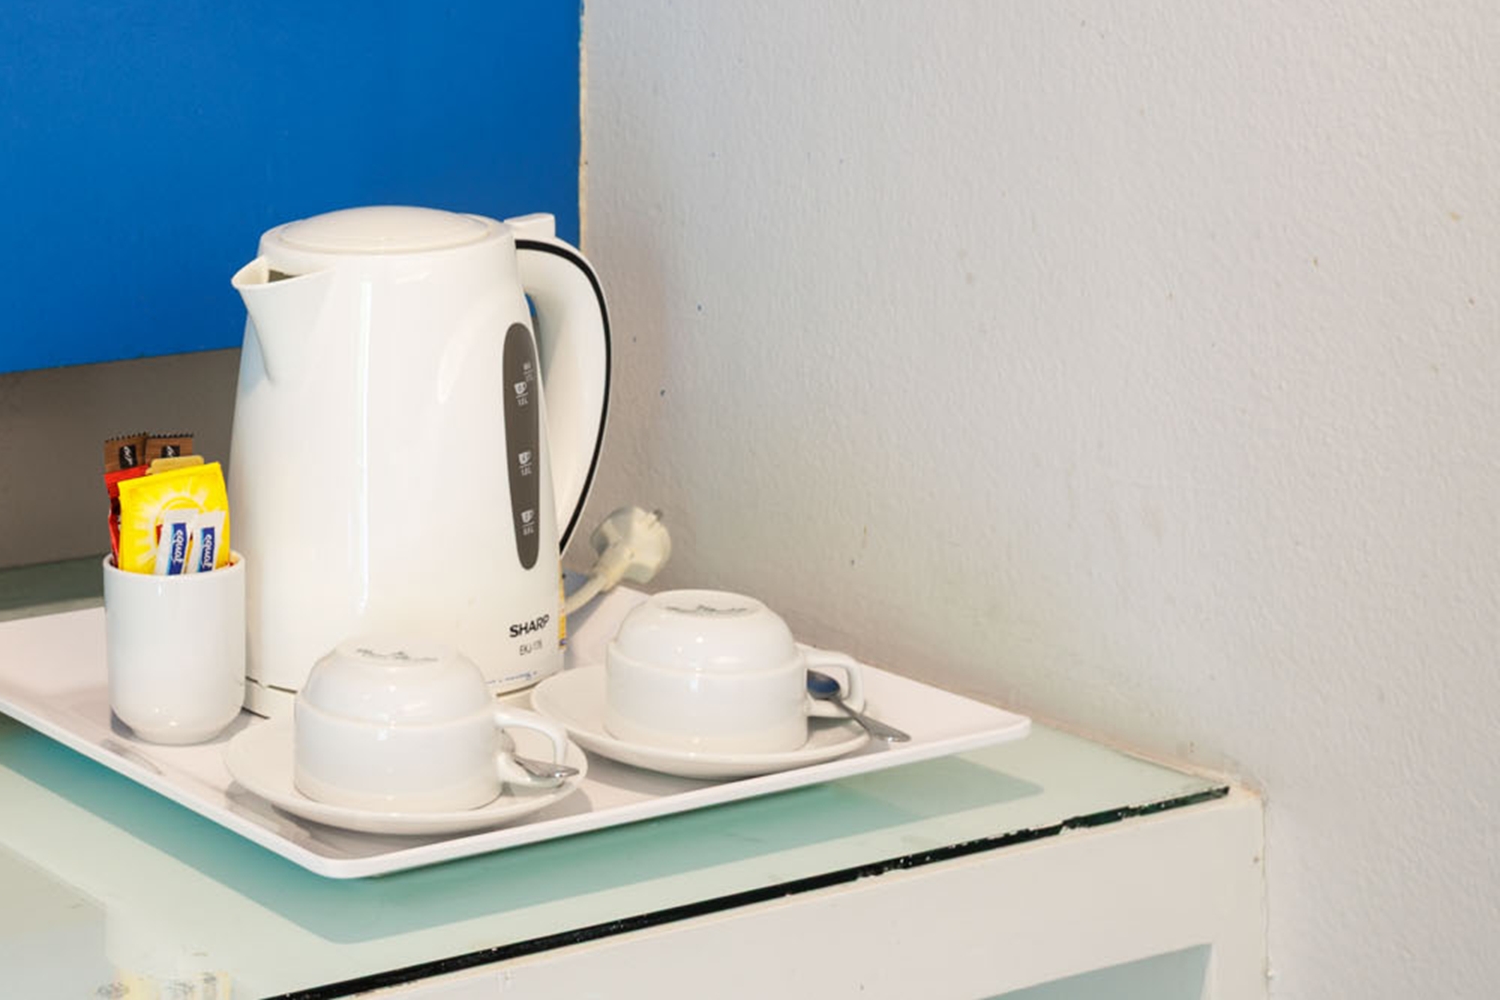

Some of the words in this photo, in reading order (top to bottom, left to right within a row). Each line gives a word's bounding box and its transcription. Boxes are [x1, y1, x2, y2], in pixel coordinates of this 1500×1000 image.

[172, 529, 184, 565] equal
[202, 534, 213, 570] equal
[509, 614, 550, 638] SHARP
